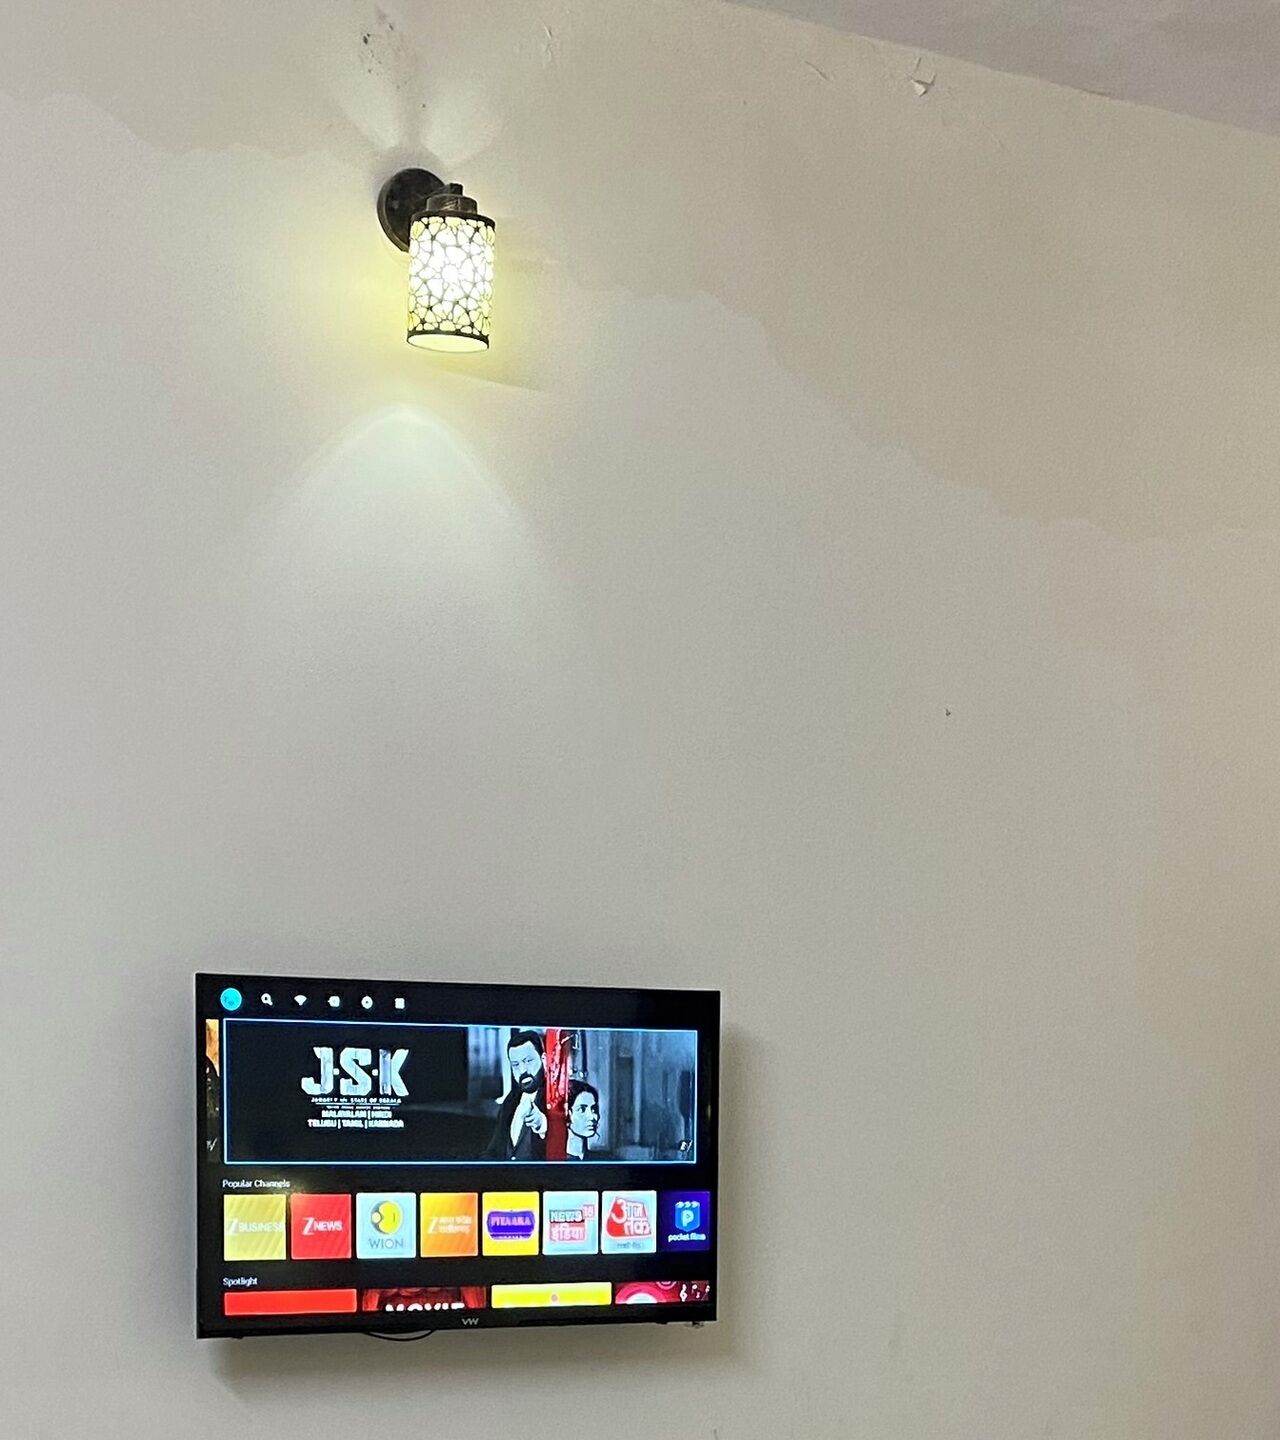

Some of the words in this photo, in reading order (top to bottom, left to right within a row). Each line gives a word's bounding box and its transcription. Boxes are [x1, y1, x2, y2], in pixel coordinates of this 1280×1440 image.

[222, 1179, 253, 1190] Popular
[254, 1179, 291, 1189] Channels
[550, 1210, 584, 1223] NEWS
[314, 1220, 343, 1232] NEWS
[368, 1238, 404, 1250] WION
[222, 1276, 258, 1287] Spotlight
